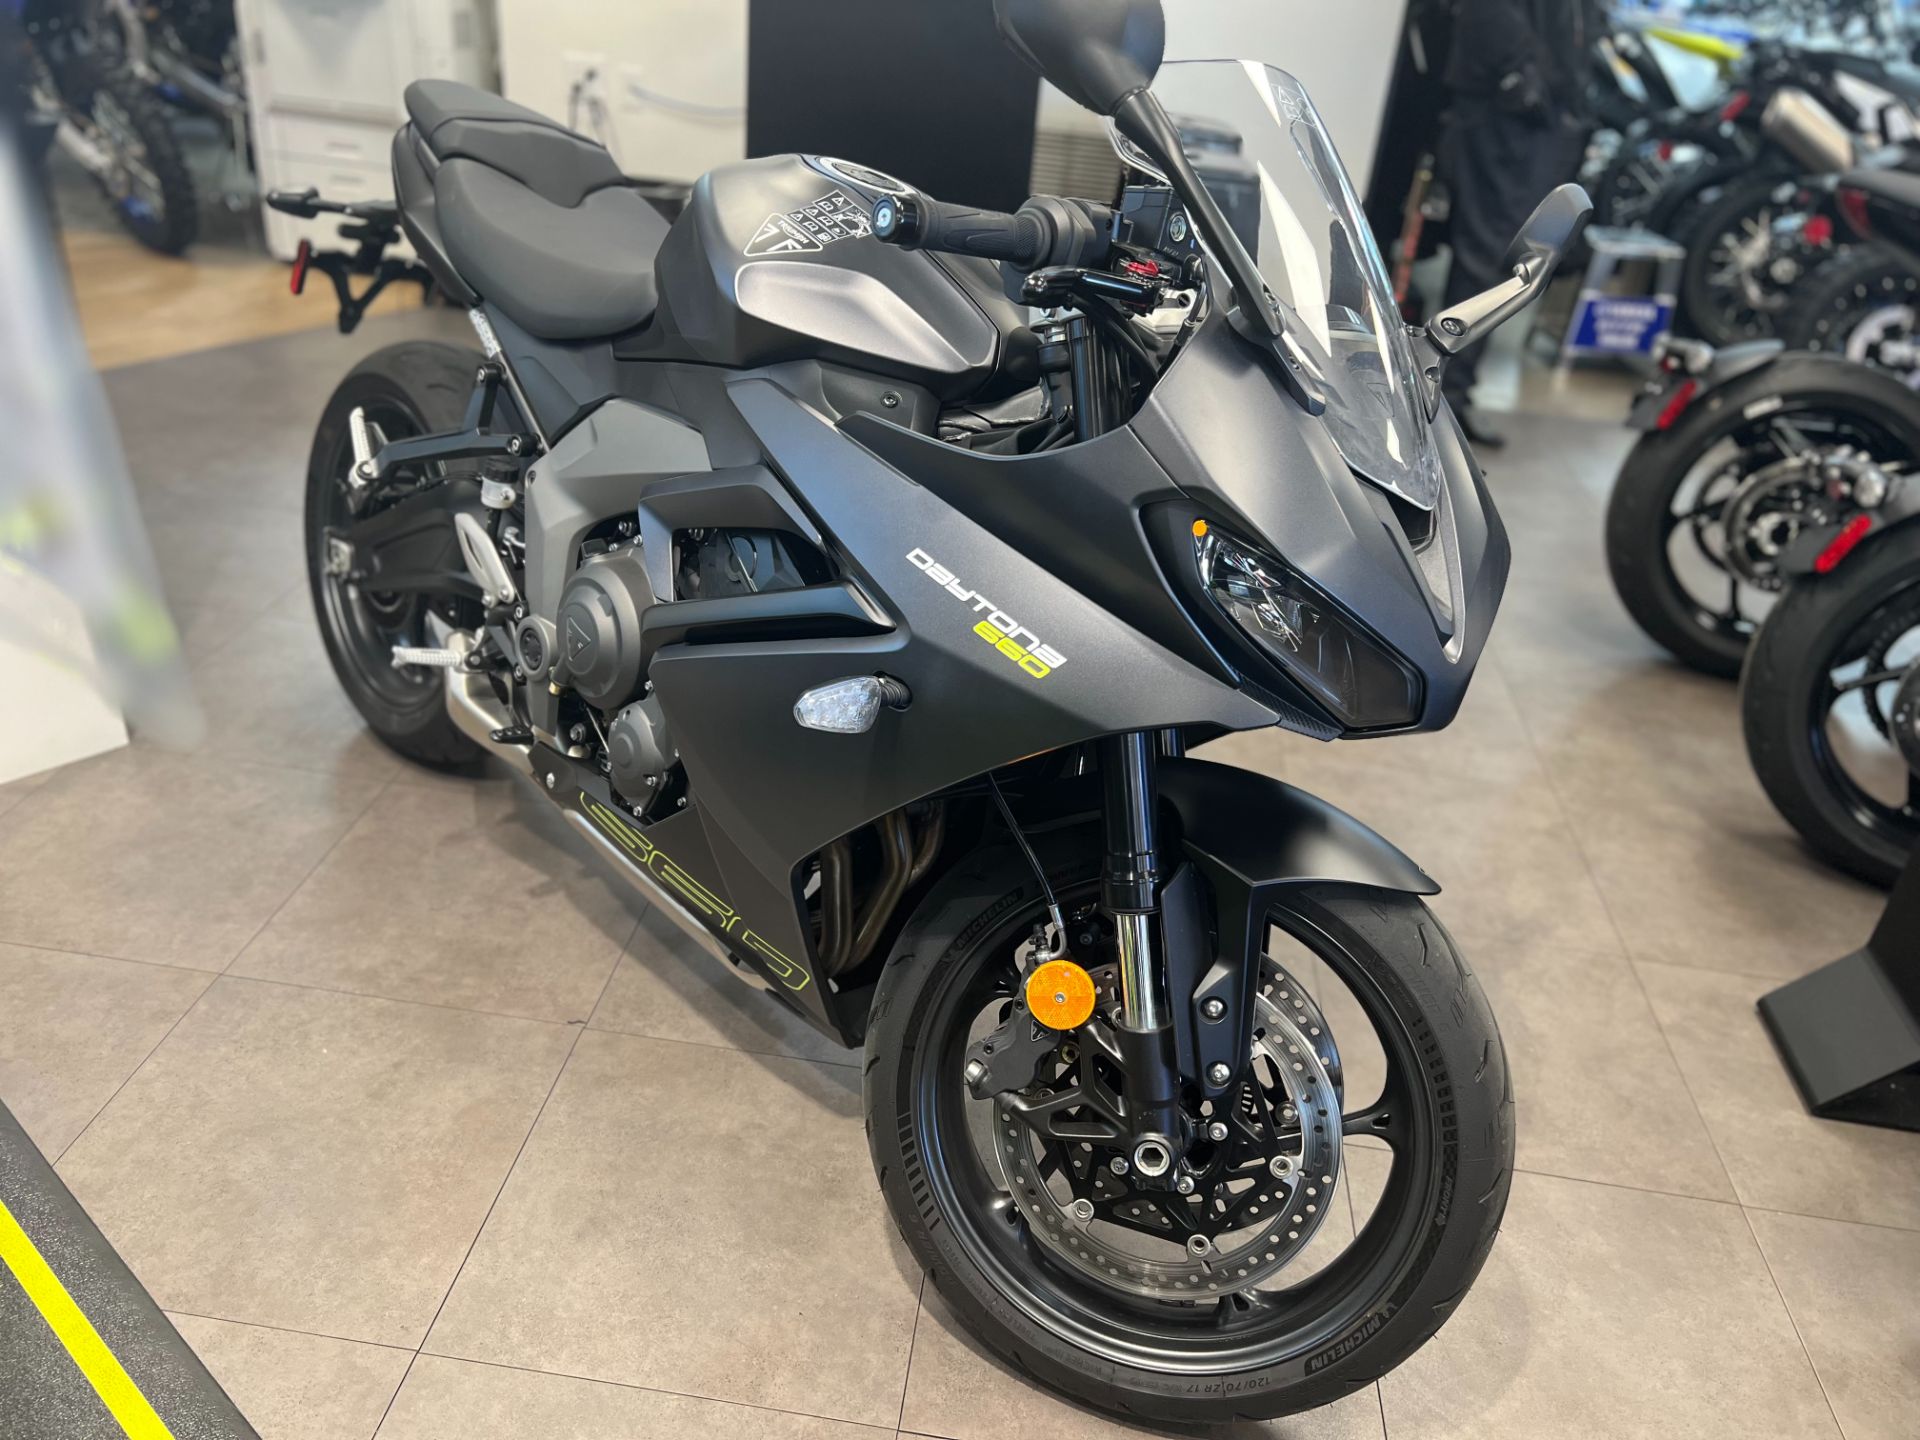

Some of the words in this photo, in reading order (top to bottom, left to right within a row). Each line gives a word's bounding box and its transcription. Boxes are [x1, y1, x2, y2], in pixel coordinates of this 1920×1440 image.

[972, 619, 1052, 679] 660
[955, 890, 1020, 950] MICHELIN
[1310, 1314, 1381, 1370] MICHELIN
[1186, 1384, 1199, 1393] 17
[1204, 1383, 1220, 1393] ZR
[1226, 1376, 1270, 1391] 120/70
